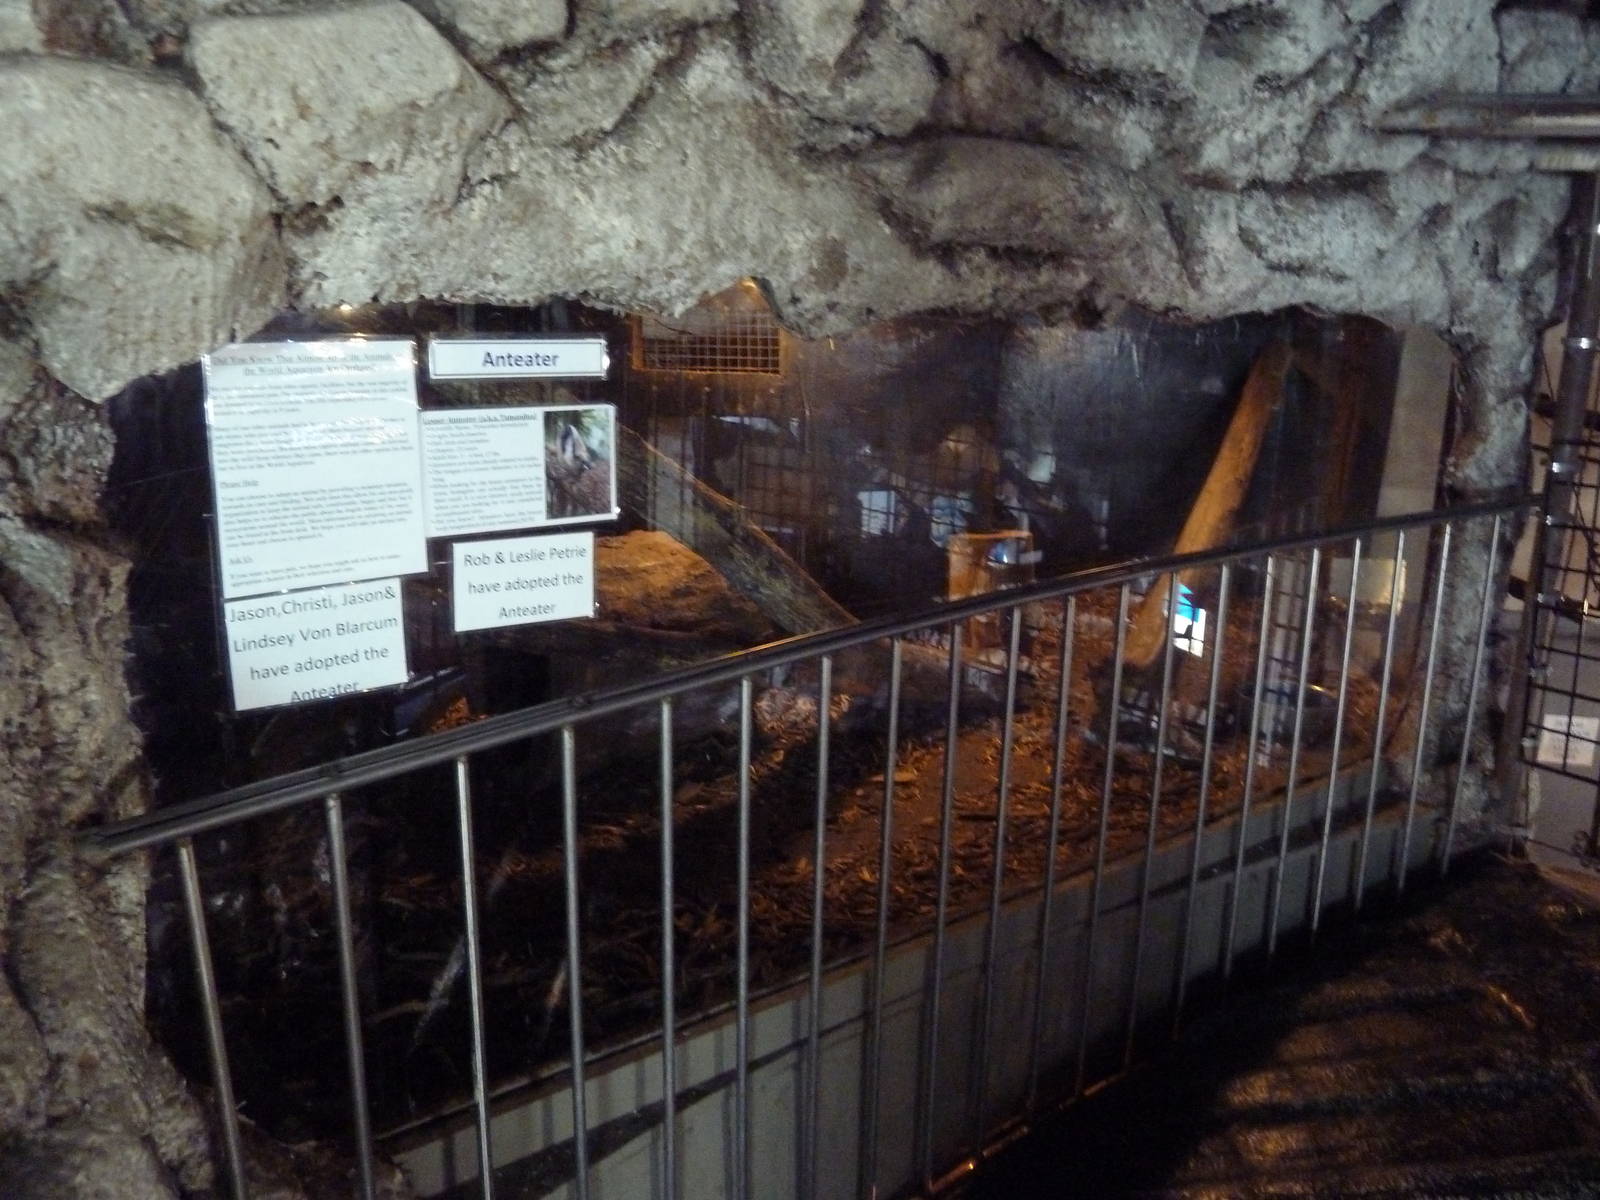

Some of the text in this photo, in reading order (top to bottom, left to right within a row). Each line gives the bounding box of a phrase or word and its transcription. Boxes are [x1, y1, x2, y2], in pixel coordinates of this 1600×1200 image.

[482, 351, 559, 367] Anteater
[464, 545, 587, 567] Rob & Leslie Petrie
[468, 572, 584, 594] have adopted the
[498, 603, 556, 619] Anteater
[233, 616, 398, 653] Lindsey Von Blarcum
[250, 646, 389, 680] have adopted the
[290, 680, 359, 702] Anteater
